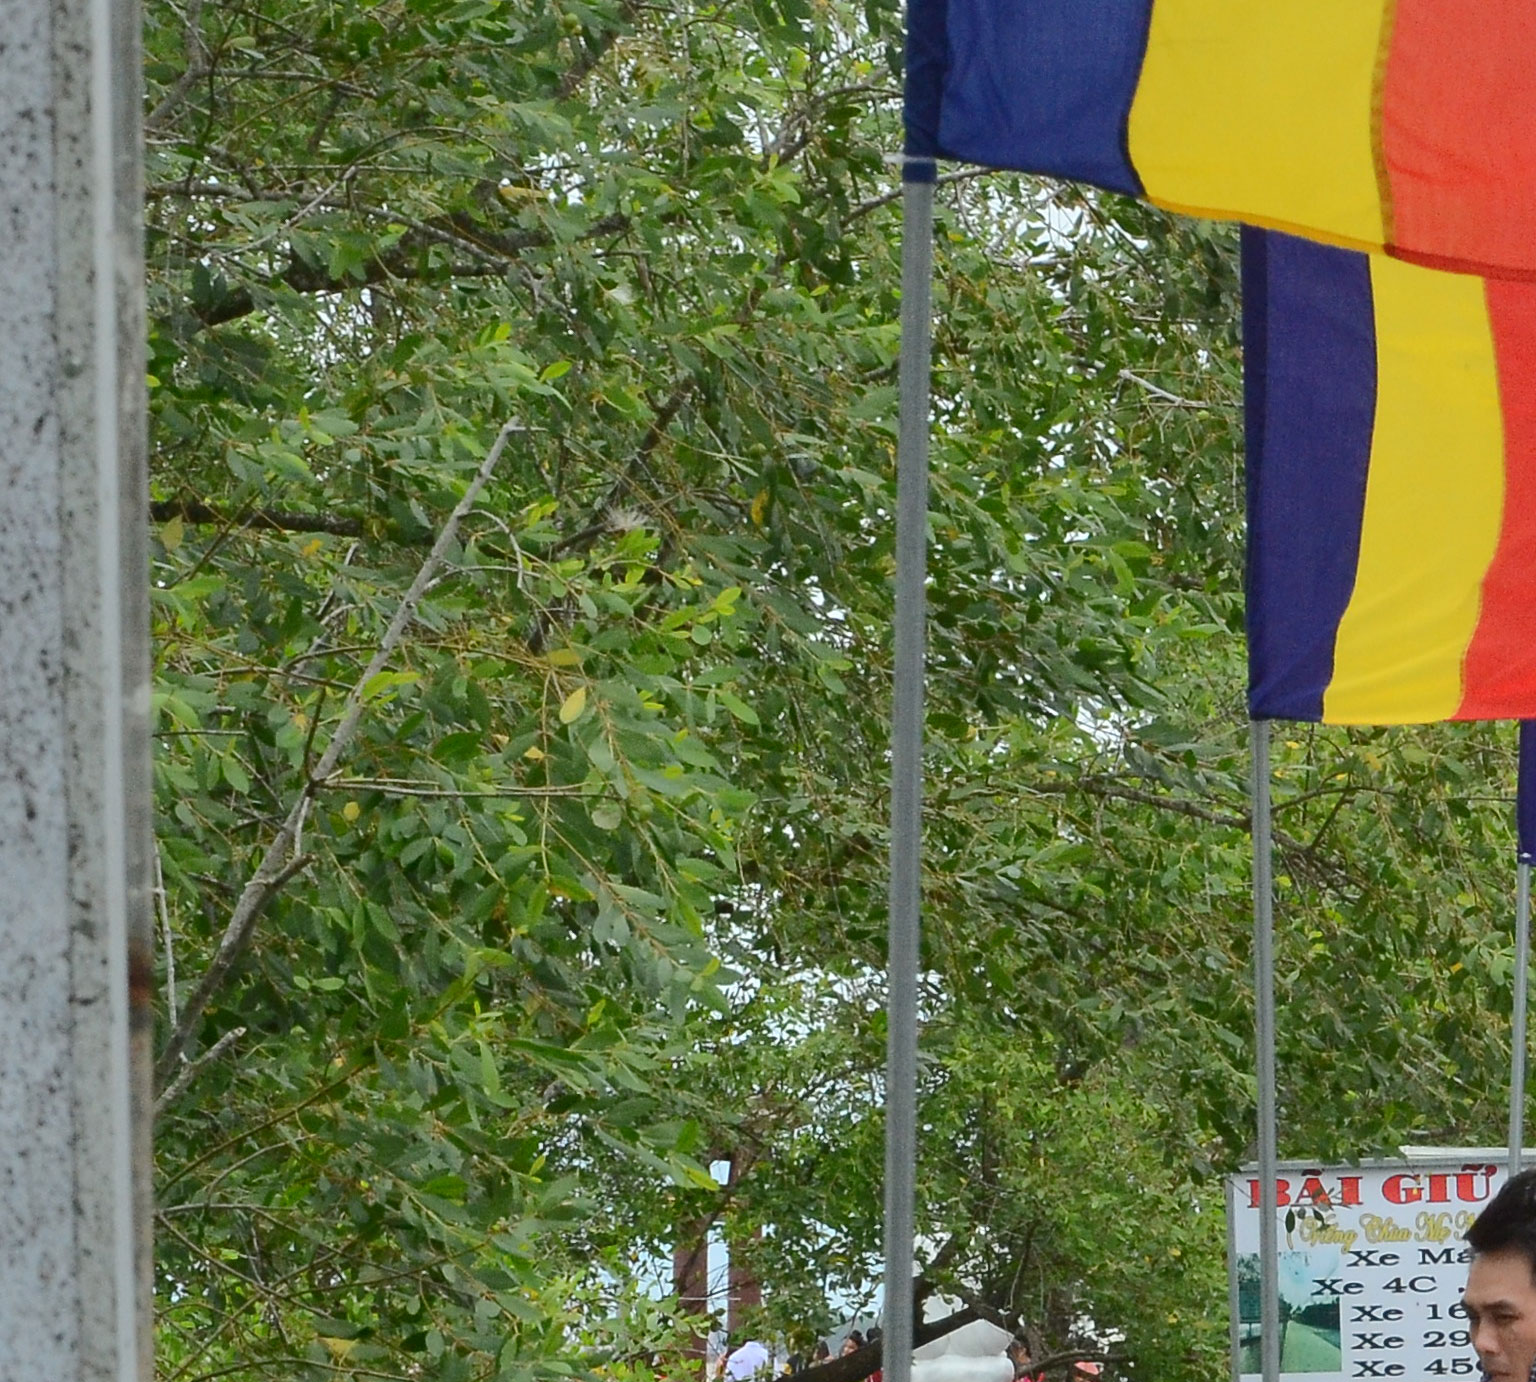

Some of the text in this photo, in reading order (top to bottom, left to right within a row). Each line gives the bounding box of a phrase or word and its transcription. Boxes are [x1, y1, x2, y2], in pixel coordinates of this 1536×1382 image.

[1246, 1168, 1364, 1210] BÃI
[1381, 1164, 1498, 1205] GIỮ
[1346, 1250, 1400, 1267] Xe
[1311, 1276, 1438, 1296] Xe 4C
[1350, 1305, 1404, 1322] Xe
[1351, 1333, 1405, 1350] Xe
[1352, 1361, 1406, 1377] Xe
